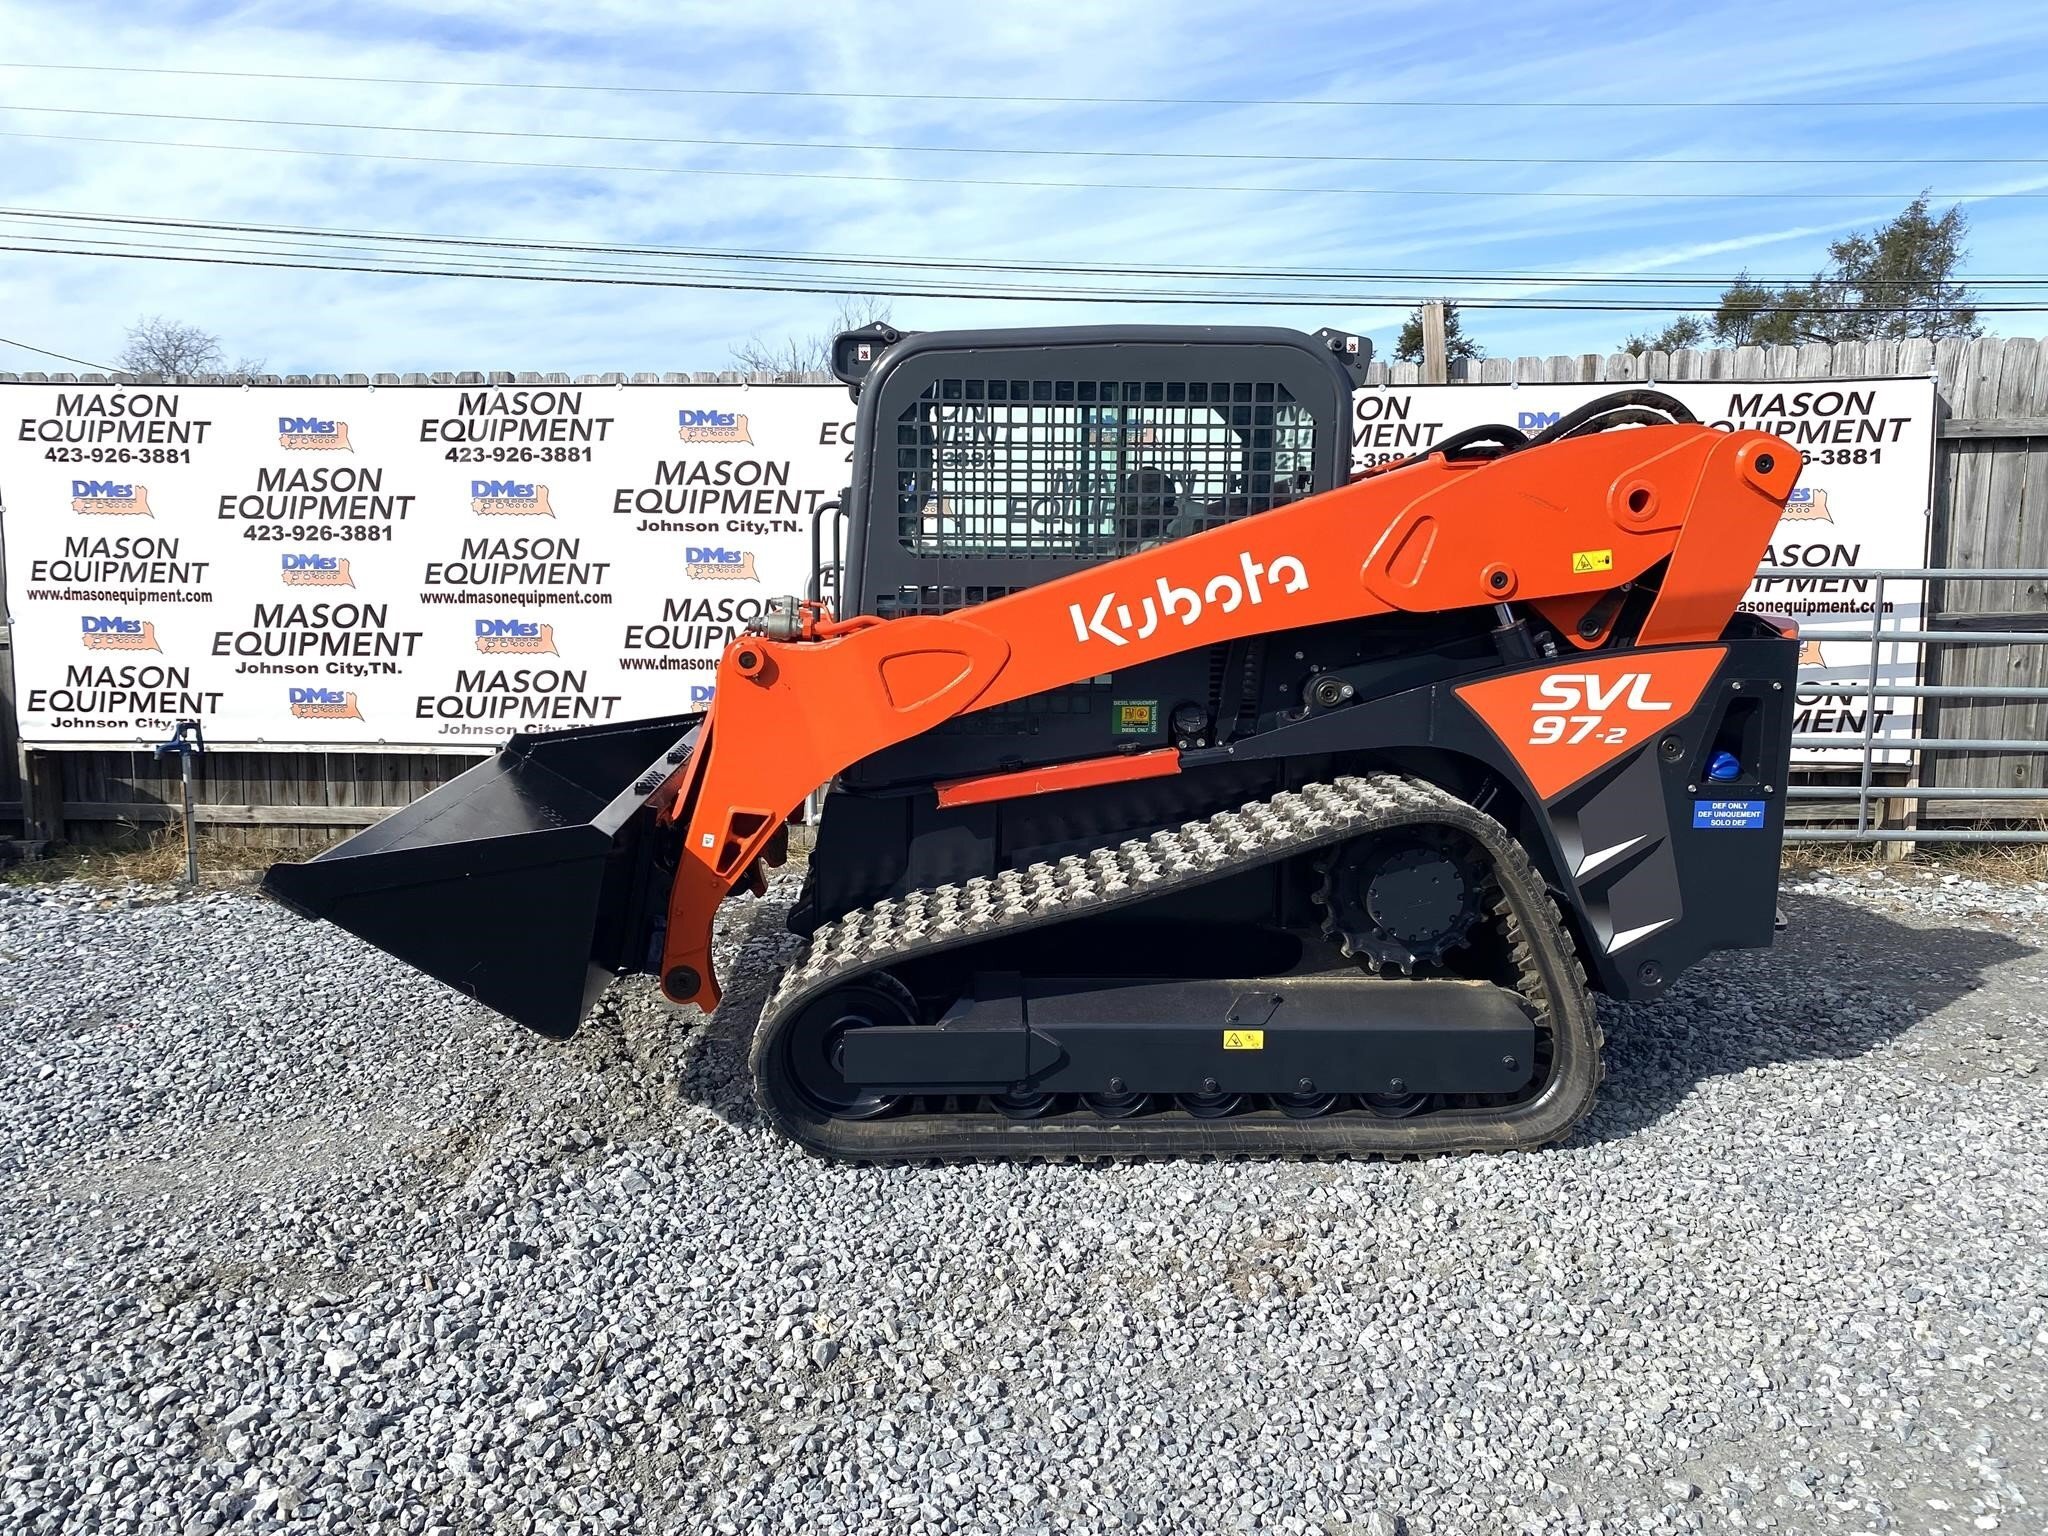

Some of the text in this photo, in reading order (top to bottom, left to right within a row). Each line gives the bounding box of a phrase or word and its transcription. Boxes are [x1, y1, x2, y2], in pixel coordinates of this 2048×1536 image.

[56, 394, 178, 417] MASON
[458, 390, 582, 415] MASON
[1728, 391, 1876, 417] MASON
[18, 419, 211, 443] EQUIPMENT
[420, 418, 614, 442] EQUIPMENT
[1518, 412, 1560, 429] DM
[45, 447, 190, 463] 423-926-3881
[445, 447, 591, 462] 423-926-3881
[1801, 448, 1881, 465] 6-3881
[257, 468, 382, 492] MASON
[655, 461, 790, 486] MASON
[218, 495, 415, 520] EQUIPMENT
[613, 489, 826, 515] EQUIPMENT
[244, 525, 391, 541] 423-926-3881
[637, 520, 803, 535] Johnson City,TN.
[65, 537, 179, 559] MASON
[461, 538, 579, 560] MASON
[1761, 543, 1861, 567] ASON
[31, 560, 209, 583] EQUIPMENT
[425, 563, 610, 584] EQUIPMENT
[27, 587, 212, 604] www.dmasonequipment.com
[420, 590, 612, 606] www.dmasonequipment.com
[1069, 551, 1310, 646] Kubota
[254, 604, 387, 628] MASON
[212, 632, 423, 656] EQUIPMENT
[624, 625, 744, 649] EQUIP
[66, 665, 189, 688] MASON
[235, 662, 402, 677] Johnson City,TN.
[456, 670, 587, 693] MASON
[1531, 673, 1673, 711] SVL
[27, 690, 223, 714] EQUIPMENT
[416, 696, 621, 719] EQUIPMENT
[51, 717, 128, 728] Johnson
[439, 724, 519, 735] Johnson
[1528, 715, 1628, 745] 97-2
